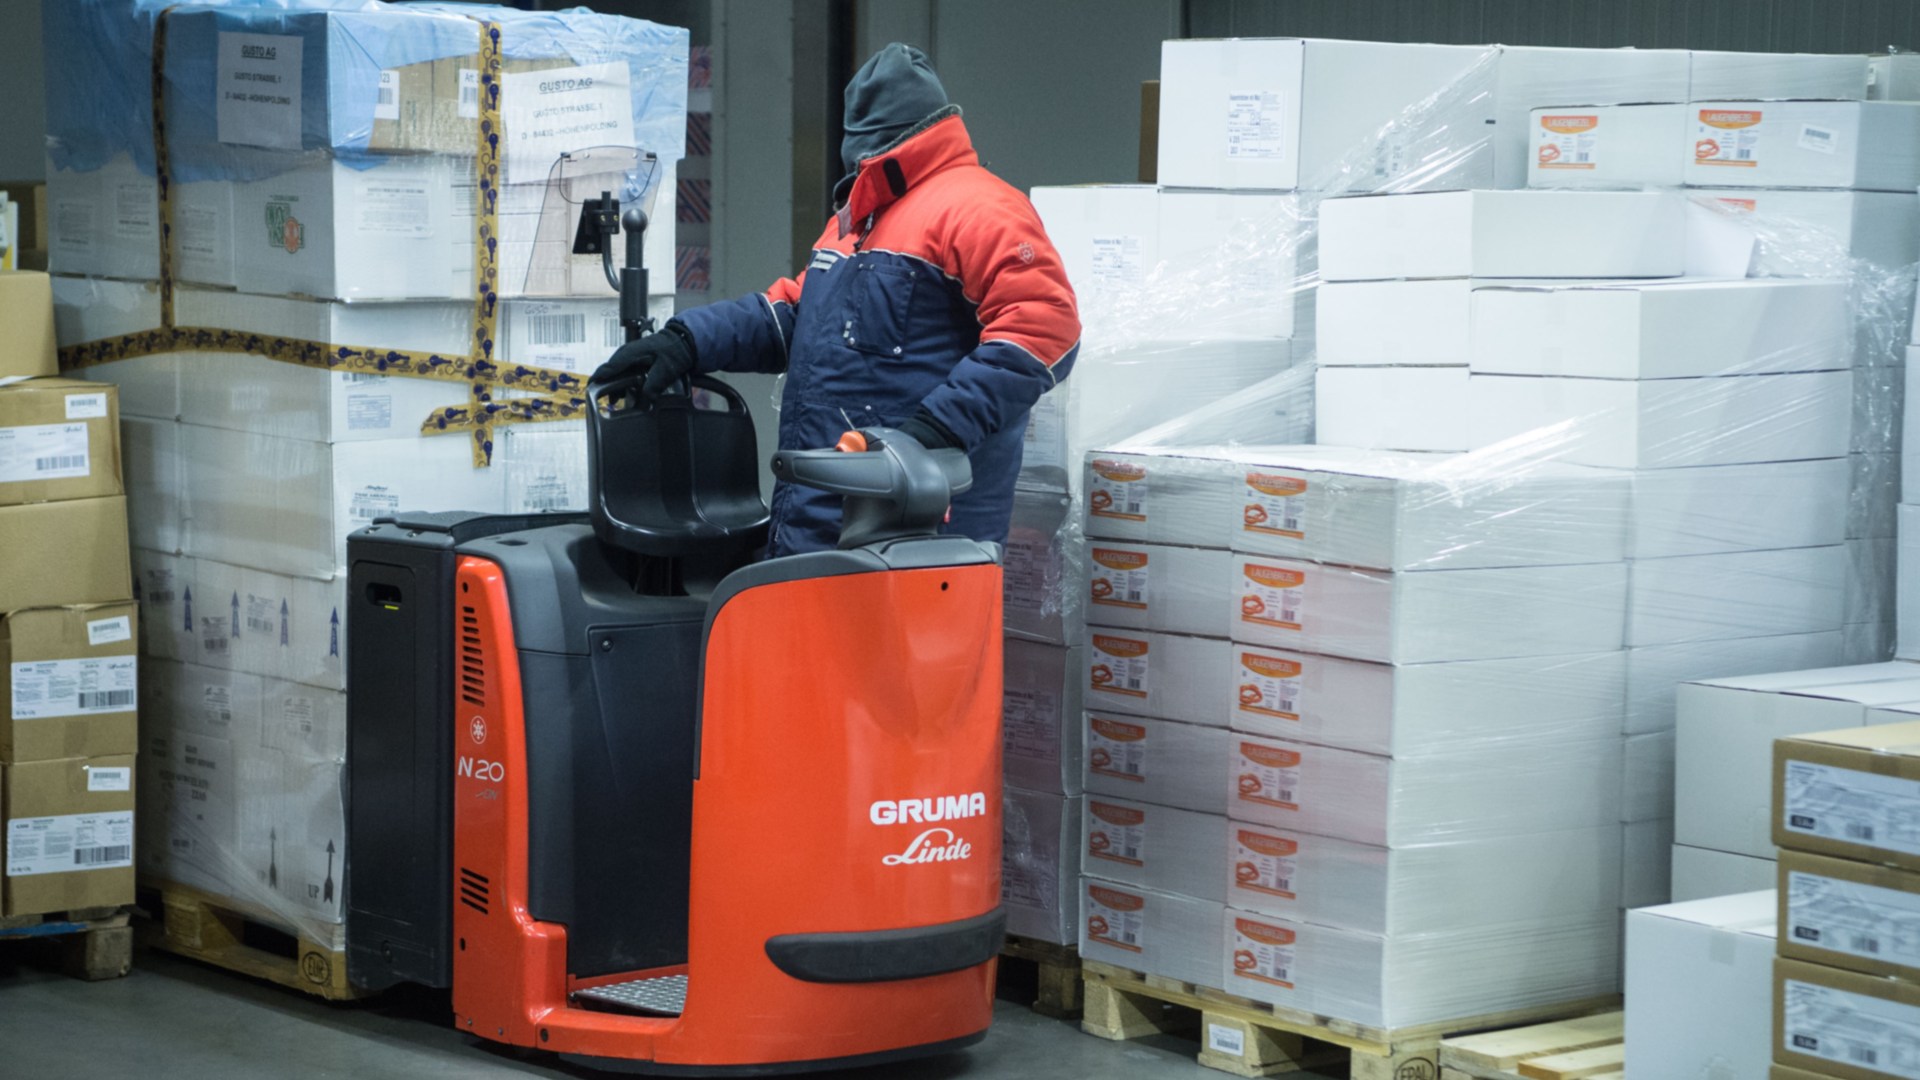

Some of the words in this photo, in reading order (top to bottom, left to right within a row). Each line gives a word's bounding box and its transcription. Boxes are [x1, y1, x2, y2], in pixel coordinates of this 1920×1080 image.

[242, 45, 264, 56] GUSTO
[266, 47, 276, 57] AG
[539, 79, 575, 93] GUSTO
[577, 77, 593, 87] AG
[1549, 117, 1590, 128] LAUGENBREZEL
[1706, 112, 1752, 123] LAUGENBREZEL
[1099, 551, 1141, 564] LAUGENBREZEL
[1251, 567, 1296, 583] LAUGENBREZEL
[1099, 638, 1141, 652] LAUGENBREZEL
[1248, 657, 1293, 672] LAUGENBREZEL
[457, 755, 473, 777] N
[475, 759, 504, 782] 20
[869, 791, 986, 825] GRUMA
[882, 827, 972, 865] Linde
[308, 884, 320, 899] UP
[307, 956, 324, 980] EUR
